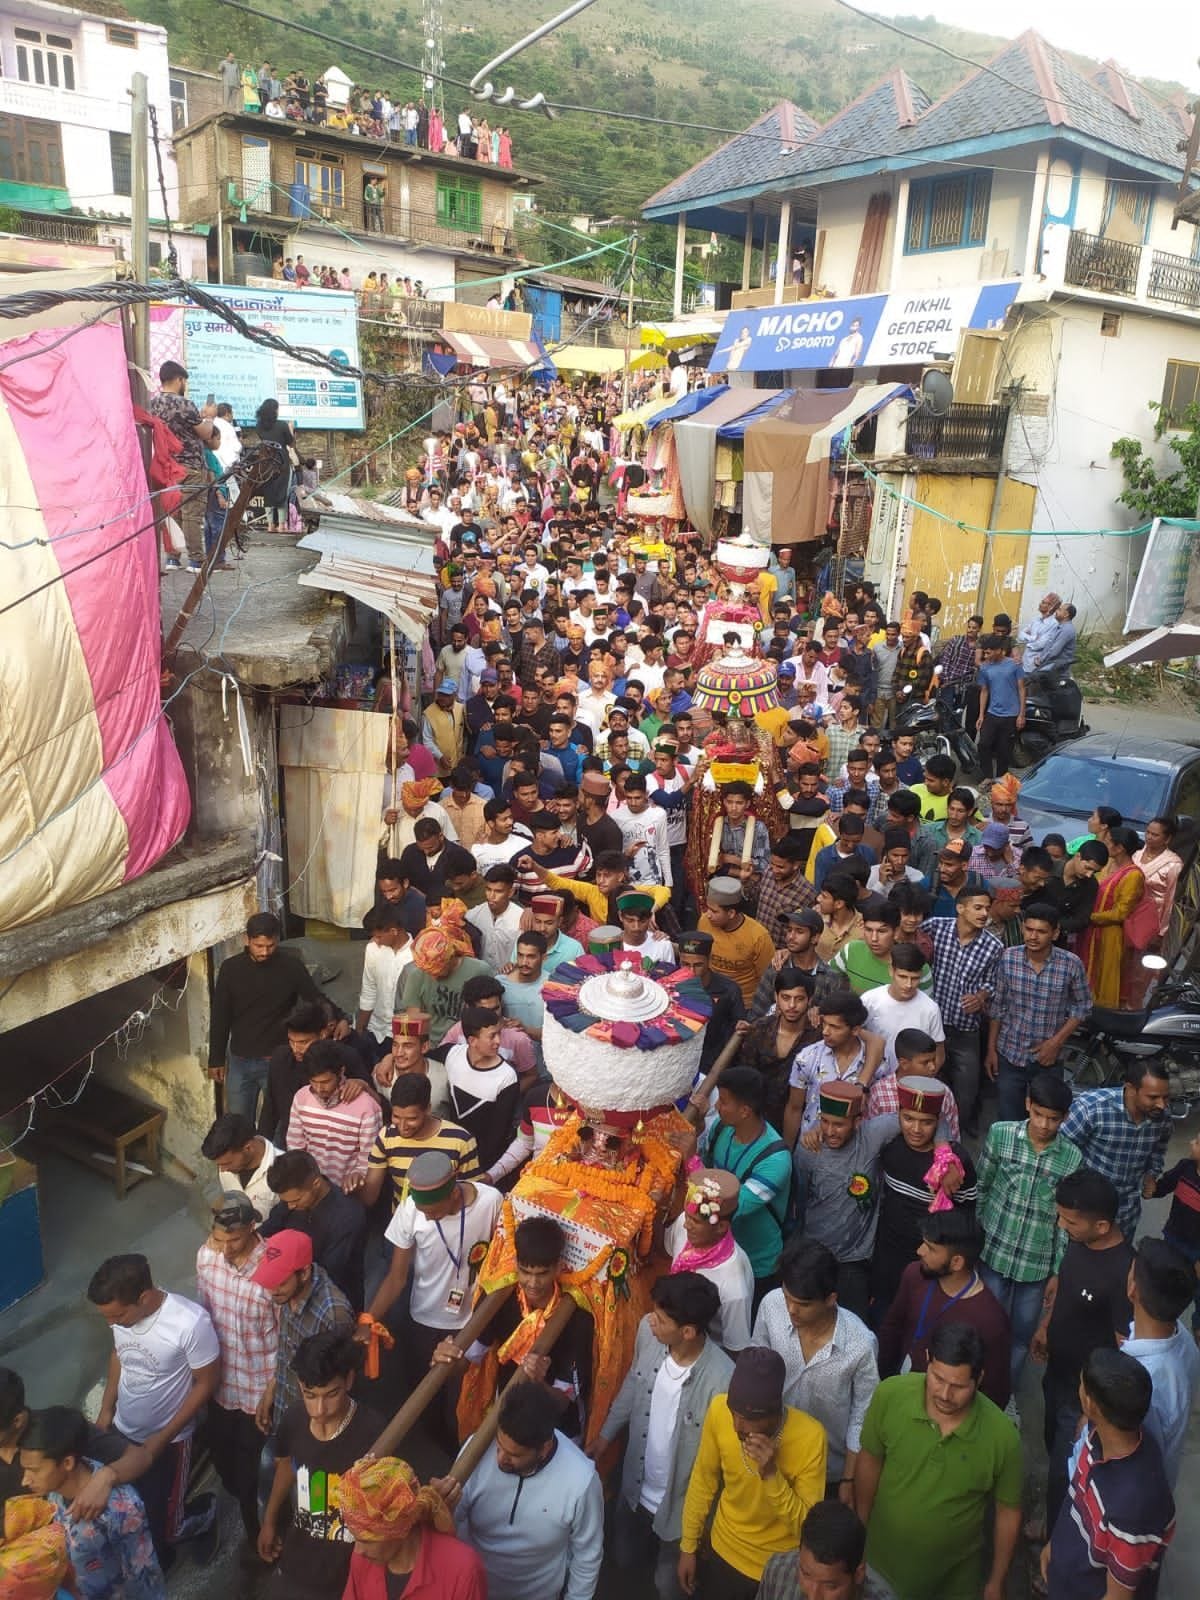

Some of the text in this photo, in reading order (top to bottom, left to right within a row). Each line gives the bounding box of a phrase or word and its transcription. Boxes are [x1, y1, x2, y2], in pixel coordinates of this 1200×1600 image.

[904, 297, 952, 313] NIKHIL
[756, 310, 844, 336] MACHO
[887, 318, 953, 335] GENERAL
[791, 335, 836, 350] SPORTO
[888, 340, 937, 356] STORE
